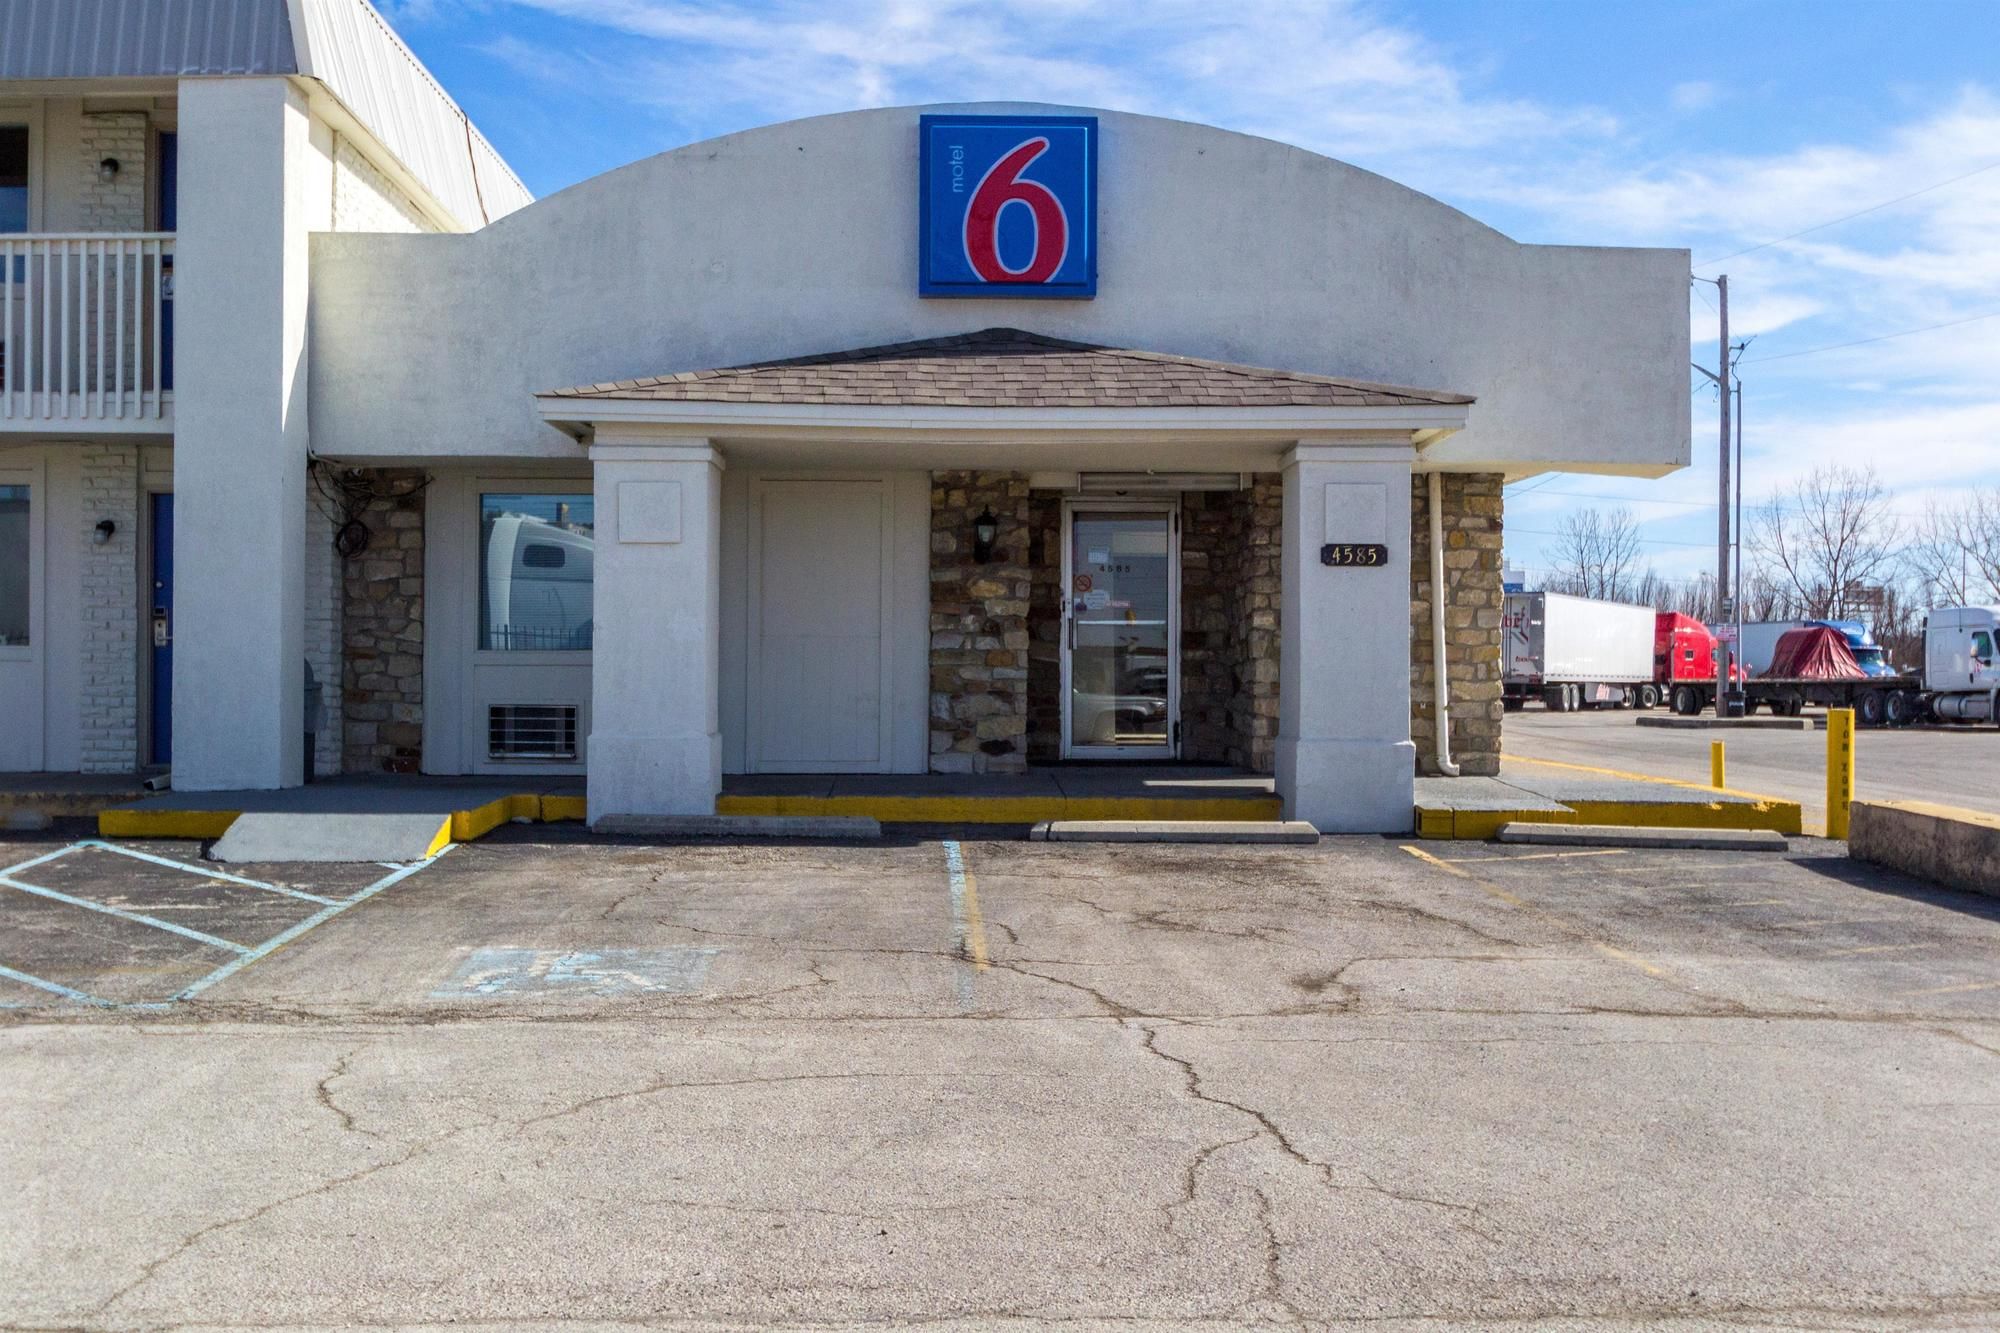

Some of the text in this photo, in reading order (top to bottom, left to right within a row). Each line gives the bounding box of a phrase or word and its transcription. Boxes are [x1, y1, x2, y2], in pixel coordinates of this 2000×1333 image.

[949, 136, 1069, 283] motel 6
[1332, 546, 1377, 564] 4585
